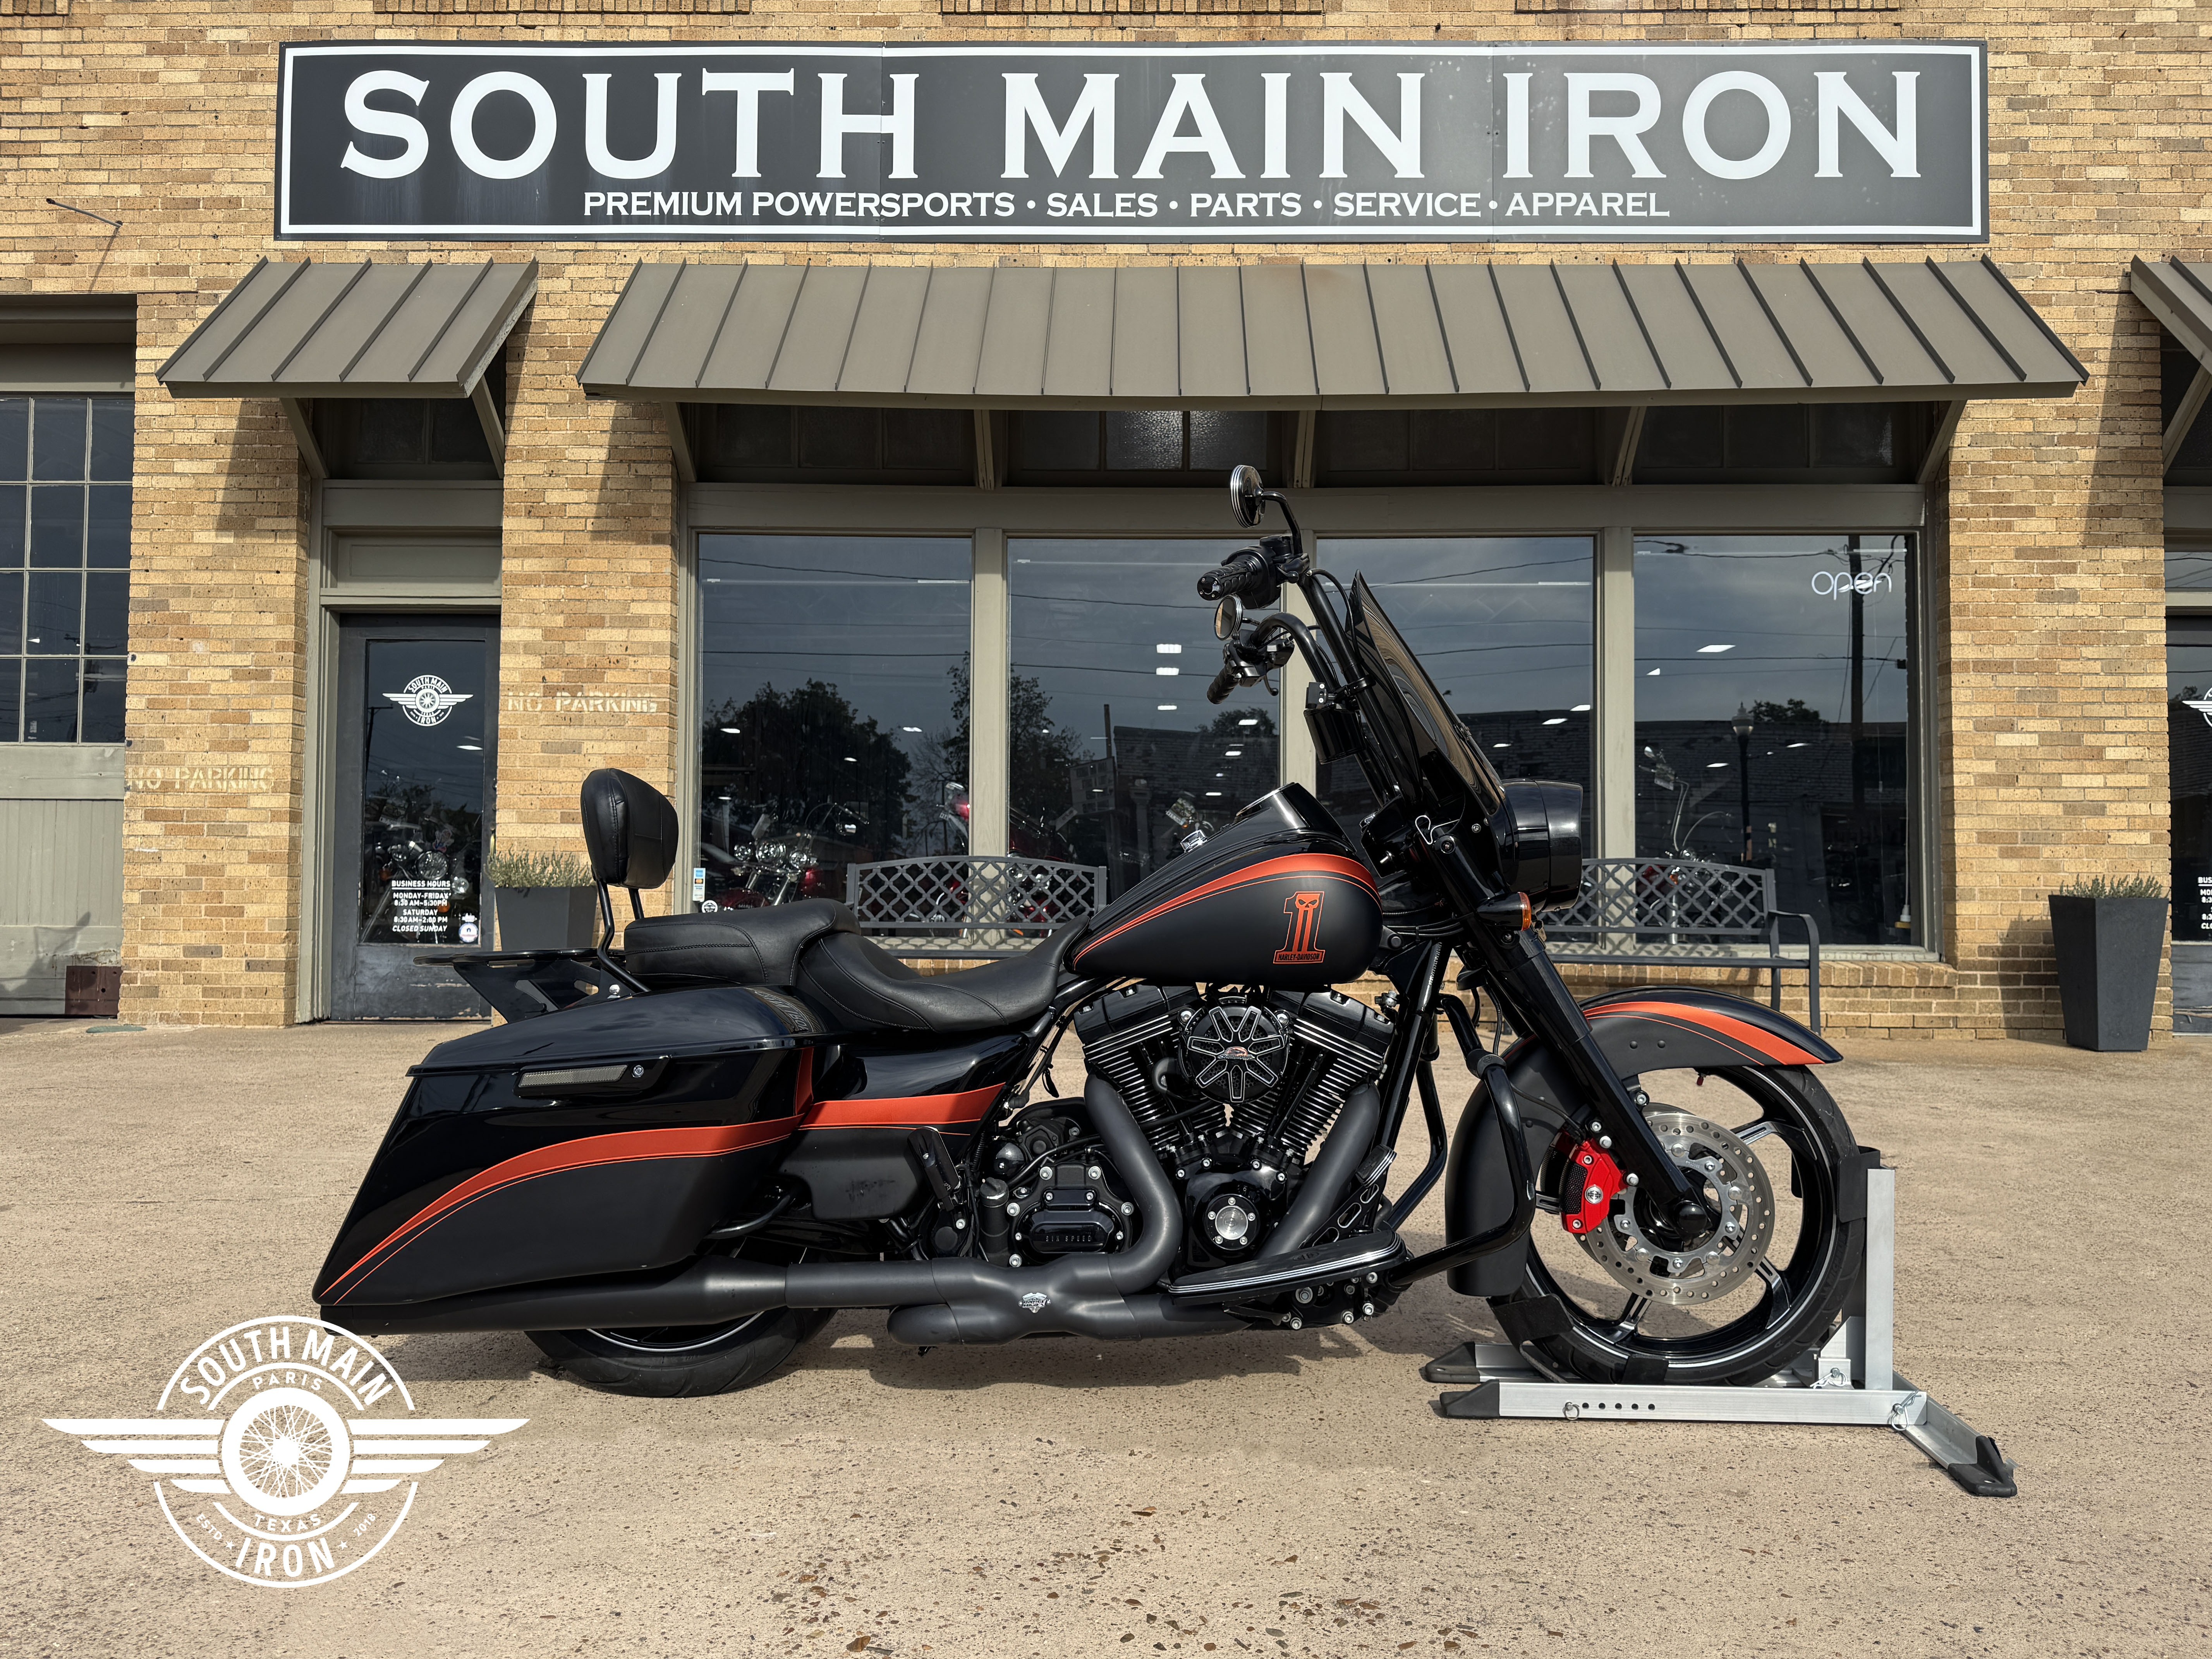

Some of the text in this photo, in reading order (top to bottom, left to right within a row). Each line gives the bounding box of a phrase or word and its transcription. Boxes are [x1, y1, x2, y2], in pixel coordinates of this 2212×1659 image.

[340, 68, 1921, 180] SOUTH MAIN IRON
[584, 191, 1670, 218] PREMIUM POWERSPORTS SALES PARTS SERVICE APPAREL
[1812, 571, 1892, 600] open
[408, 677, 448, 693] SOUTH MAIN
[508, 692, 658, 713] NO PARKING
[127, 767, 274, 790] NO PARKING
[1278, 953, 1320, 961] HARLEY-DAVIDSON
